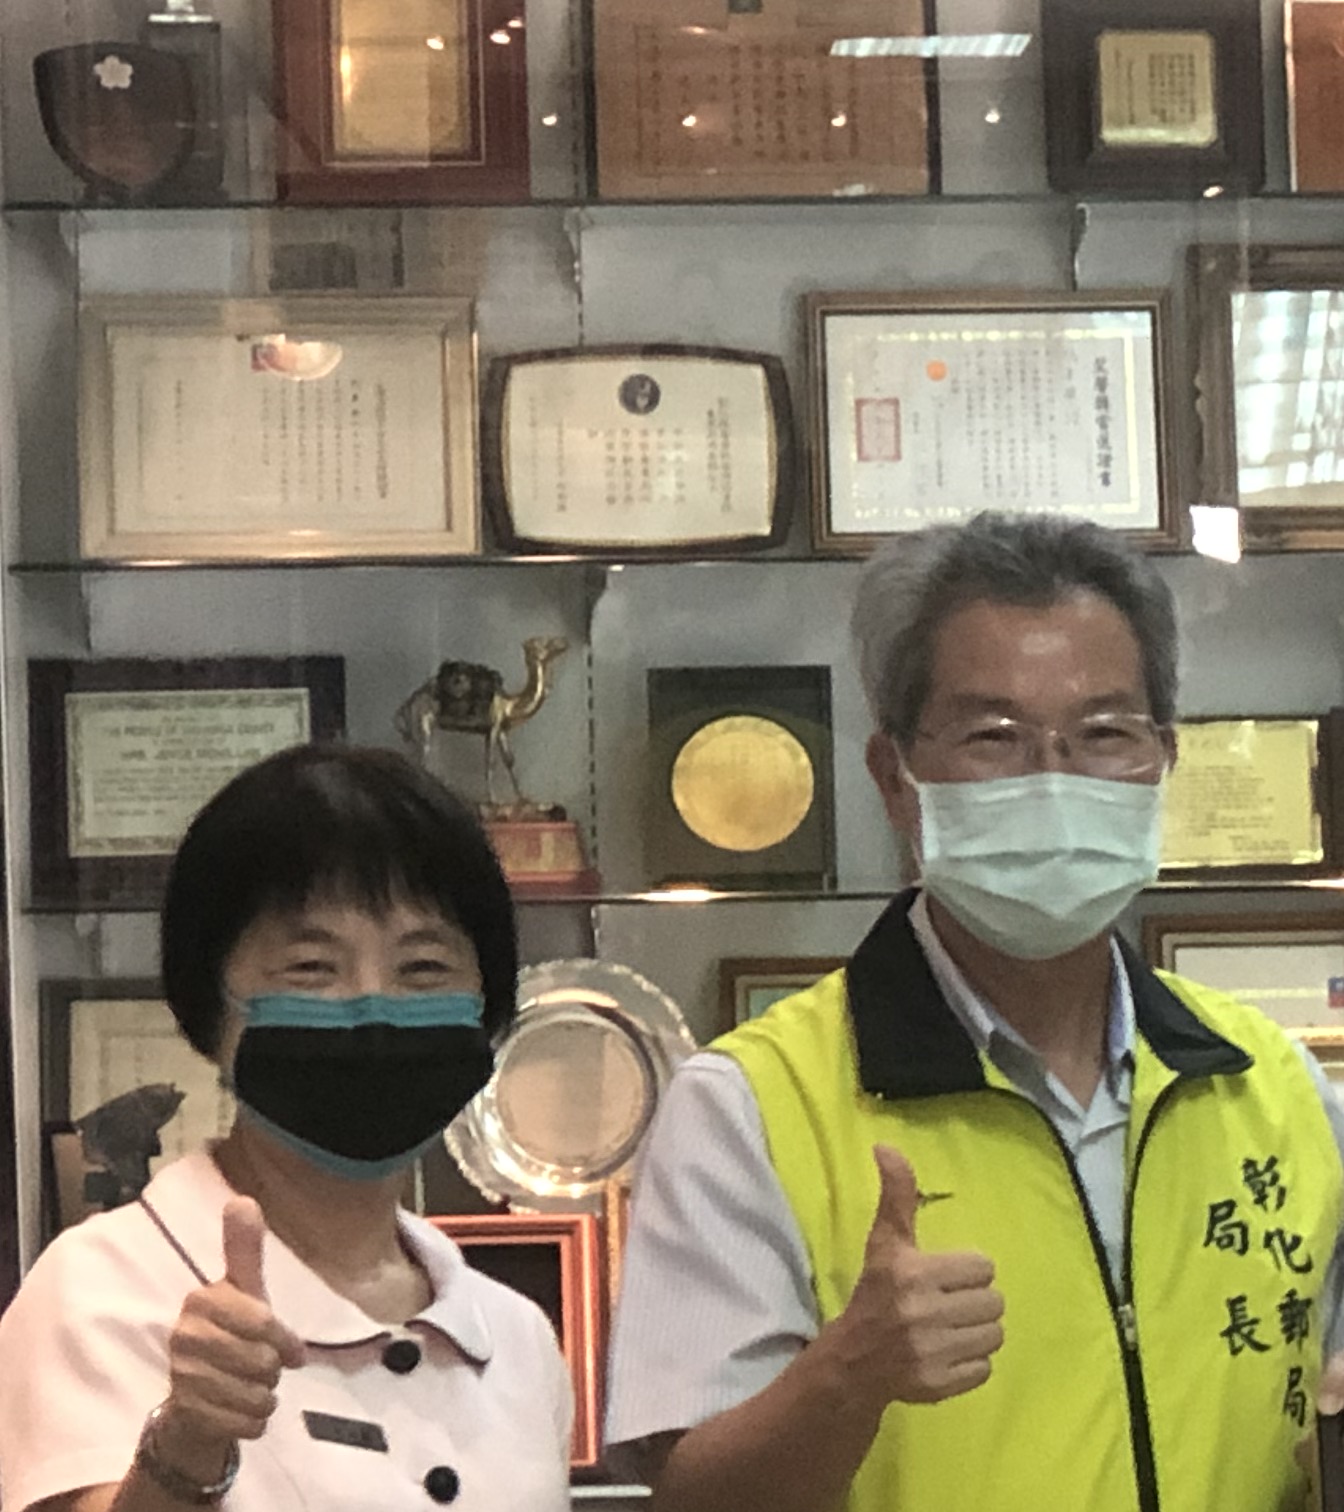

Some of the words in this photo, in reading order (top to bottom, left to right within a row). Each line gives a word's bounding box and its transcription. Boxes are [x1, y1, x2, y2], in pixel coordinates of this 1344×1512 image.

[1203, 1199, 1271, 1357] 局長
[1241, 1155, 1314, 1428] 彰化郵局
